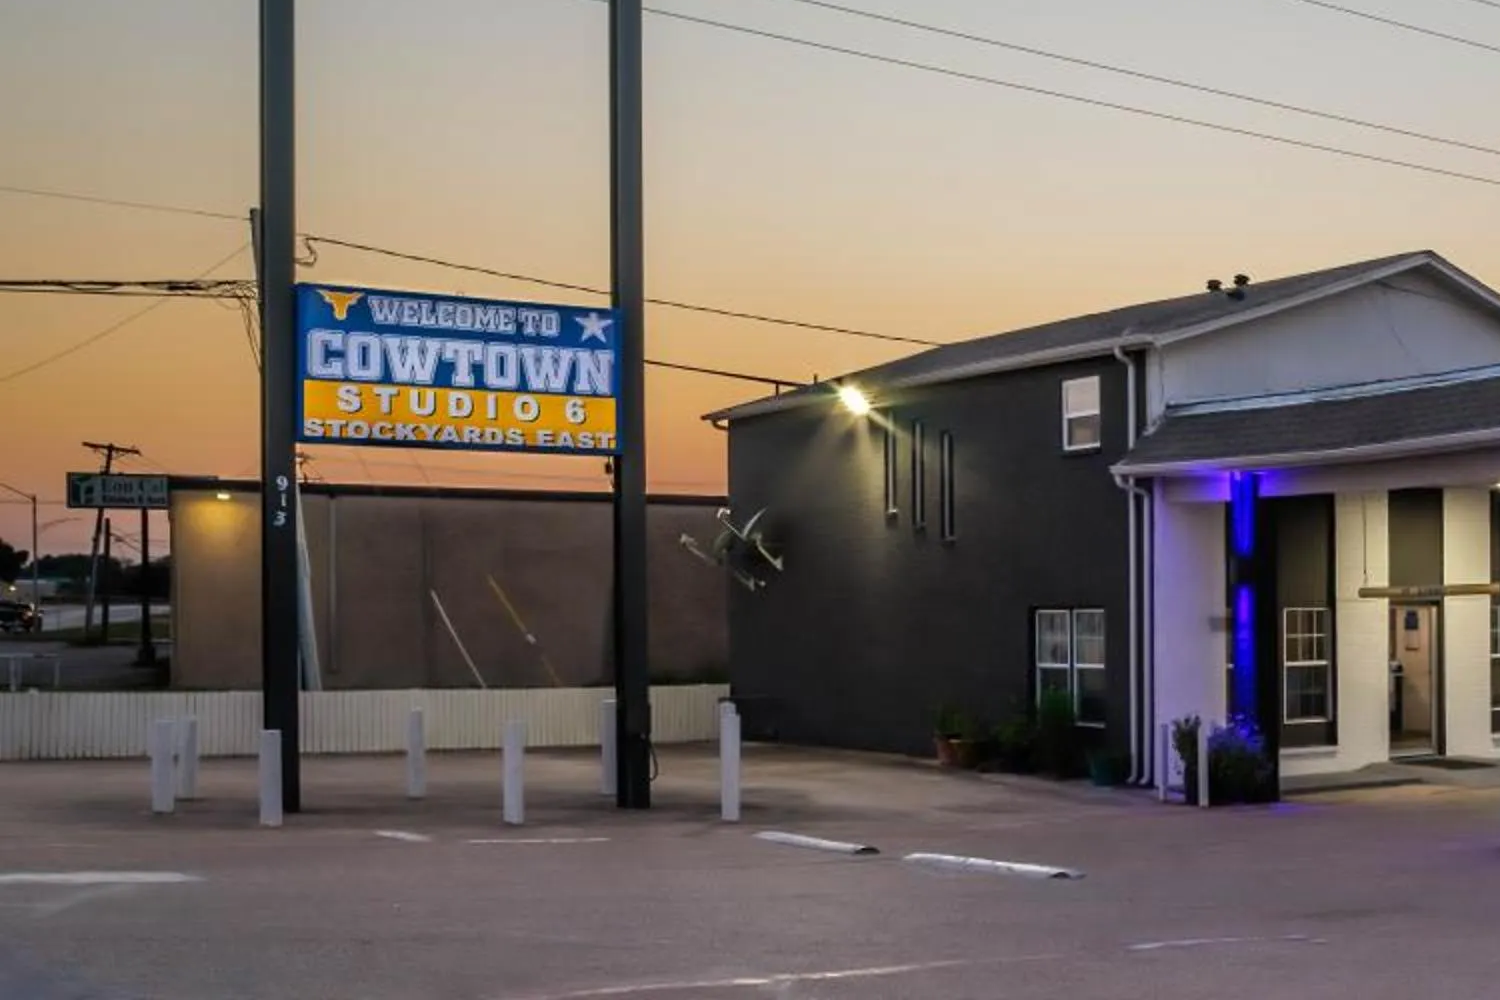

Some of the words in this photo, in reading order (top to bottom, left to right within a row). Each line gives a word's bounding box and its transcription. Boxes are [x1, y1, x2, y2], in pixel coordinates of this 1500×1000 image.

[367, 296, 517, 335] WELCOME
[517, 307, 562, 338] TO
[306, 327, 615, 396] COWTOWN
[336, 383, 541, 423] STUDIO
[565, 398, 588, 425] 6
[303, 417, 526, 446] STOCKYARDS
[535, 428, 616, 449] EAST
